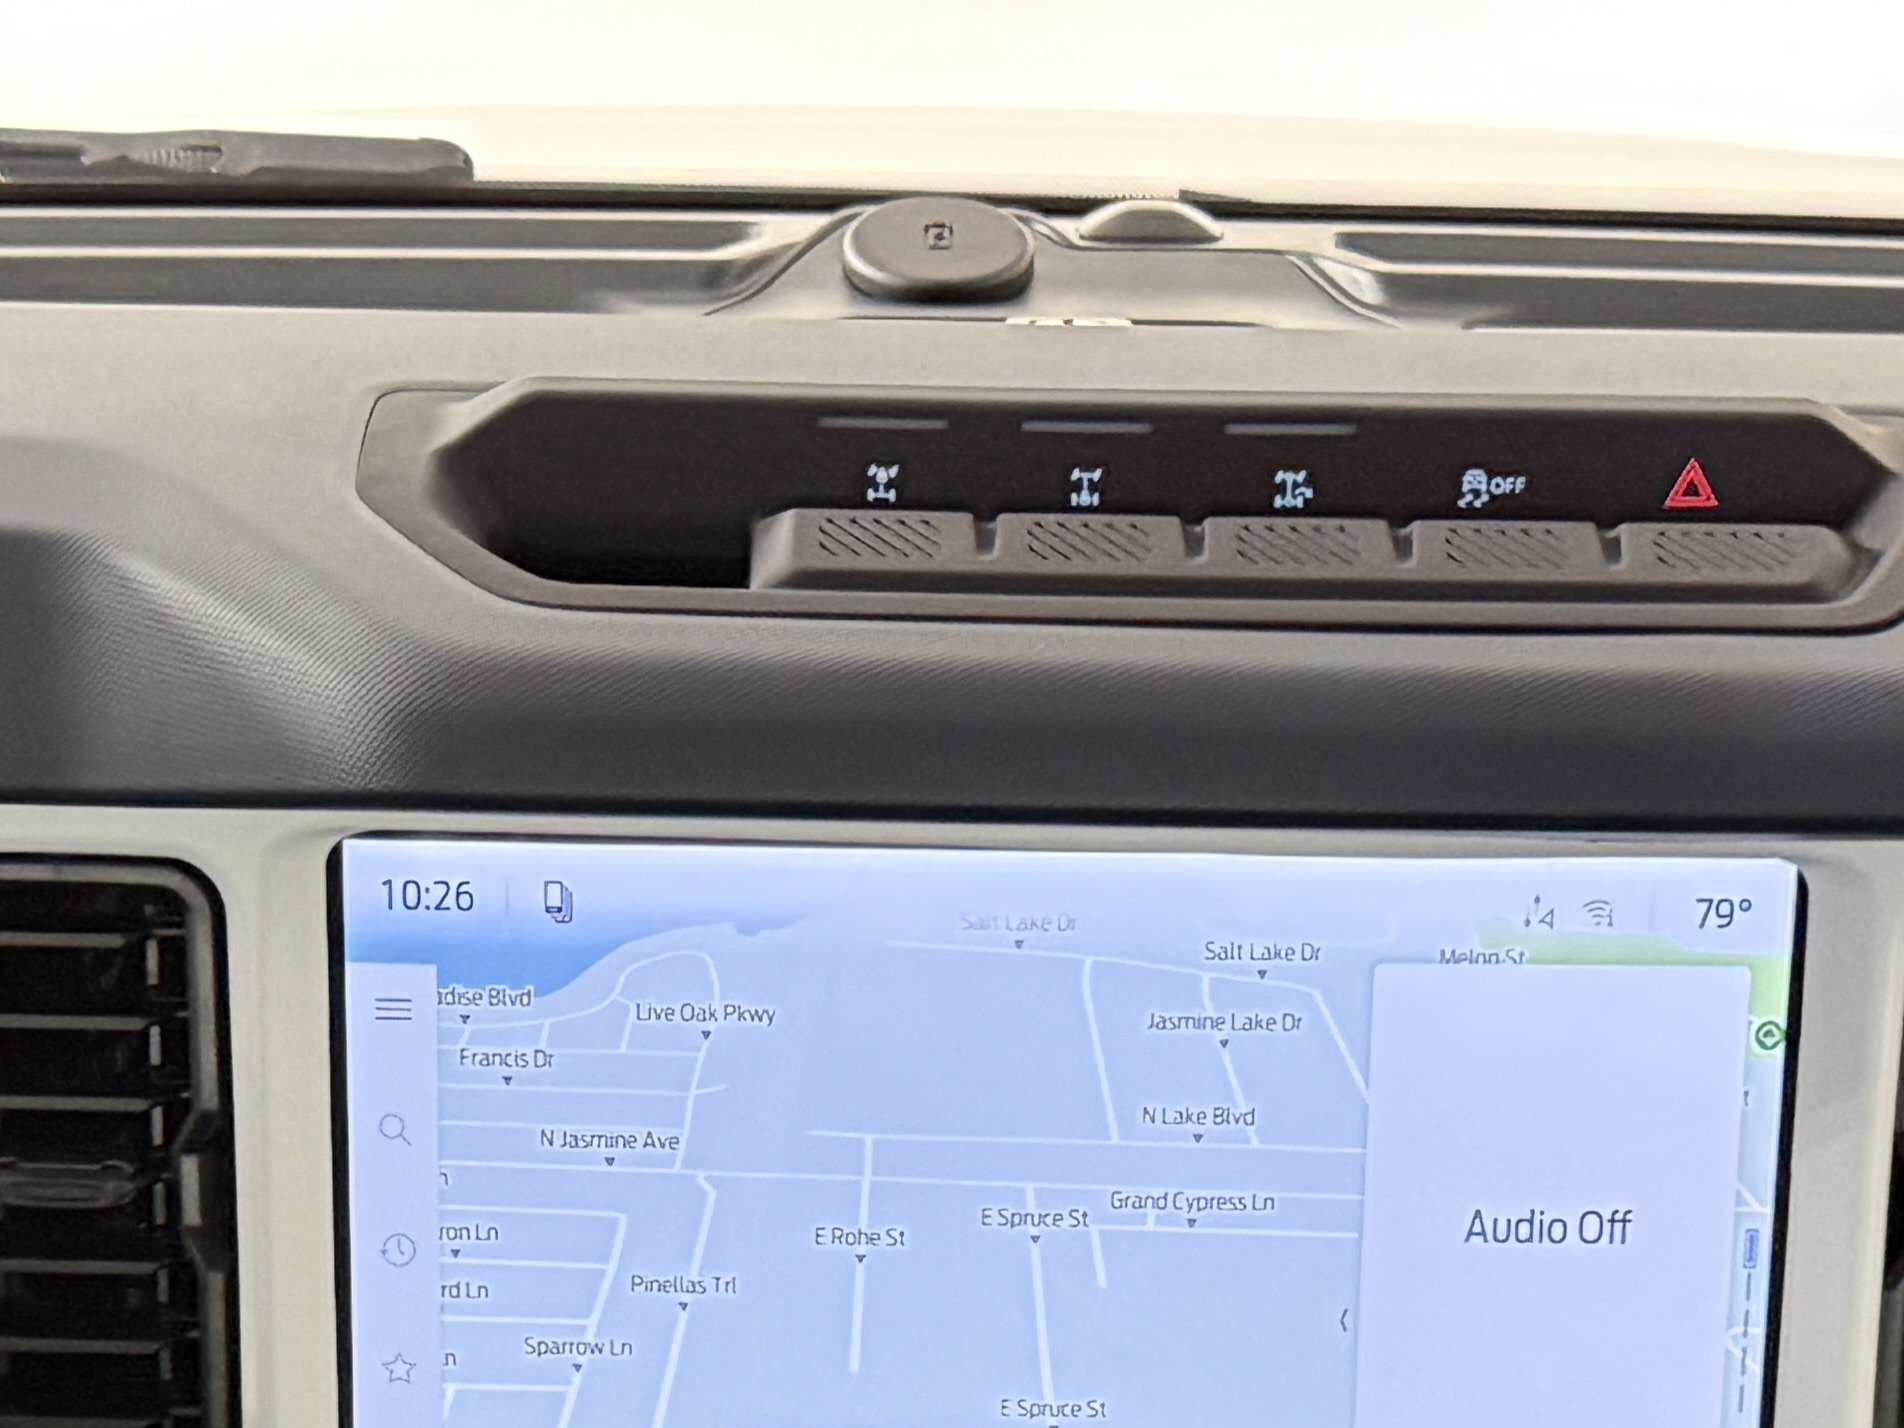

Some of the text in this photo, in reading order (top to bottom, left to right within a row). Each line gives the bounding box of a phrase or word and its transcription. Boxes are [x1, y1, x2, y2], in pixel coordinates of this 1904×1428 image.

[1489, 475, 1527, 495] OFF
[381, 879, 475, 912] 10:26
[1005, 914, 1052, 932] Lake
[1057, 913, 1078, 932] Dr
[1695, 898, 1752, 929] 79°
[1204, 942, 1321, 963] Salt Lake Dr
[488, 987, 532, 1007] Blvd
[636, 1002, 776, 1028] Live Oak Pkwy
[1147, 1011, 1303, 1033] Jasmine Lake Dr
[459, 1048, 555, 1069] Francis Dr
[1142, 1107, 1256, 1127] N Lake Blvd
[540, 1130, 680, 1152] N Jasmine Ave
[1110, 1191, 1275, 1217] Grand Cypress Ln
[981, 1208, 1089, 1229] E Spruce St
[1464, 1209, 1633, 1246] Audio Off
[476, 1223, 499, 1241] Ln
[815, 1227, 905, 1247] E Rohe St
[466, 1281, 489, 1300] Ln
[631, 1275, 737, 1296] Pinellas Trl
[524, 1337, 633, 1359] Sparrow Ln
[1001, 1399, 1107, 1422] E Spruce St
